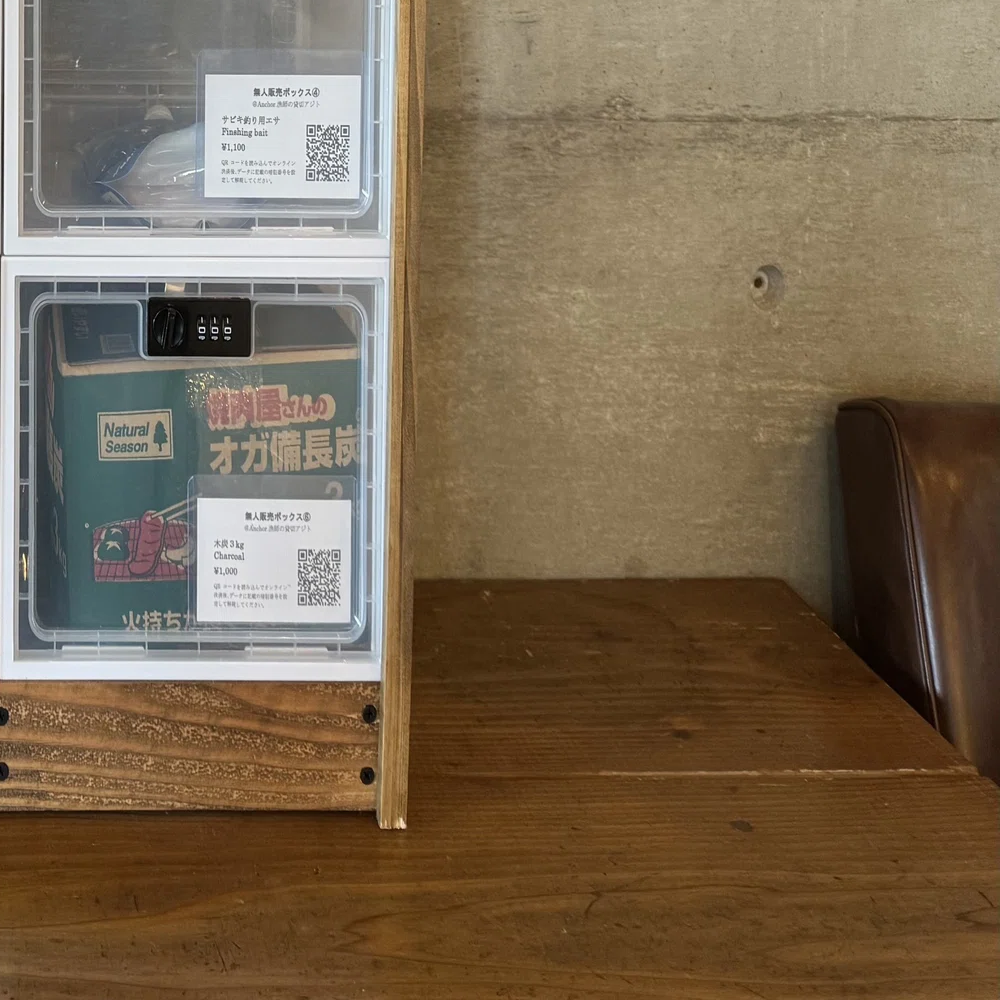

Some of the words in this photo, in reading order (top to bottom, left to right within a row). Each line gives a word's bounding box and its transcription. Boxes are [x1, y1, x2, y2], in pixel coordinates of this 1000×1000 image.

[253, 87, 320, 98] 無人販売ボックス④
[254, 128, 268, 137] bait
[221, 143, 246, 152] ¥1,100
[104, 421, 149, 438] Natural
[105, 441, 149, 454] Season
[245, 512, 311, 522] 無人販売ボックス⑥
[214, 552, 245, 561] Charcoal
[214, 567, 238, 576] ¥1,000
